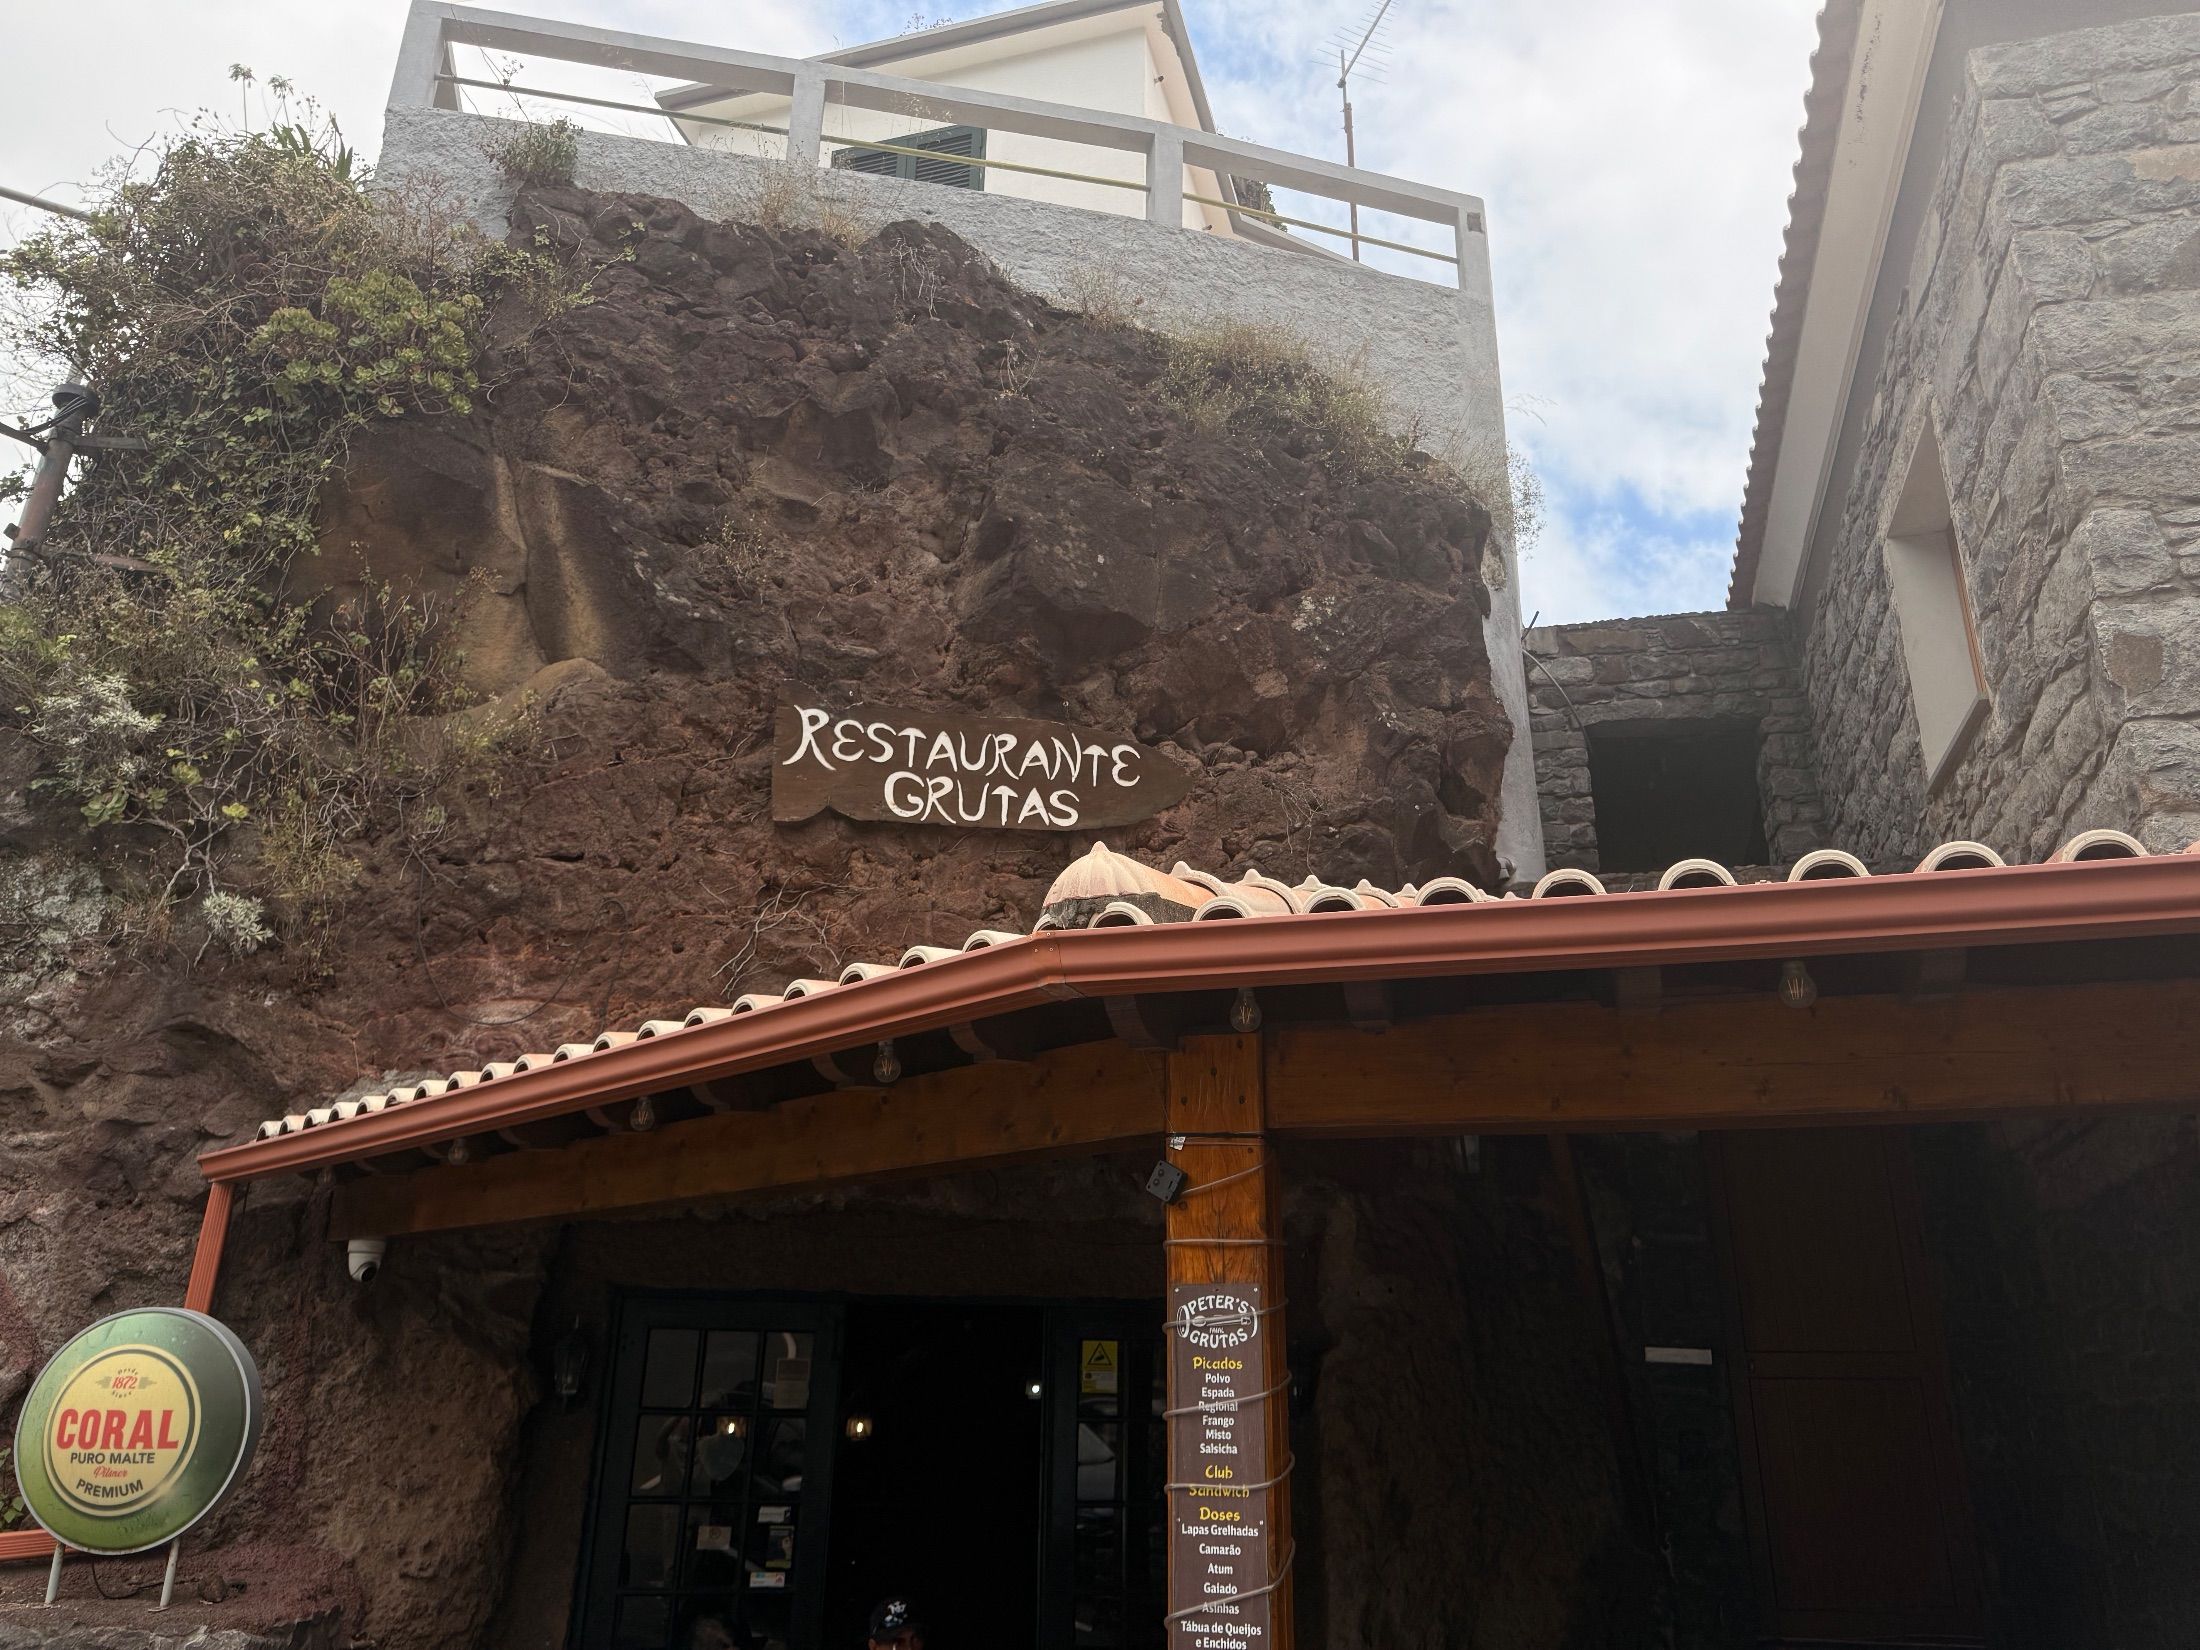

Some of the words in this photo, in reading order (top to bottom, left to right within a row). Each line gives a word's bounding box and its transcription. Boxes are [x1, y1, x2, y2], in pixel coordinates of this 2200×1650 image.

[782, 704, 1141, 788] RESTAURANTE
[884, 771, 1080, 827] GRUTAS
[1189, 1295, 1249, 1315] PETER'S
[1190, 1328, 1248, 1348] GRUTAS
[1192, 1356, 1243, 1370] Picados
[111, 1375, 138, 1389] 1872
[1205, 1373, 1231, 1384] Polvo
[1201, 1387, 1235, 1399] Espada
[1198, 1401, 1238, 1413] Regional
[1202, 1415, 1235, 1428] Frango
[56, 1408, 179, 1450] CORAL
[1205, 1429, 1232, 1440] Misto
[1200, 1443, 1238, 1455] Salsicha
[70, 1452, 105, 1464] PURO
[109, 1452, 155, 1464] MALTE
[93, 1465, 128, 1479] Pilsner
[1205, 1465, 1233, 1479] Club
[76, 1478, 144, 1498] PREMIUM
[1189, 1483, 1250, 1498] Sandwich
[1199, 1506, 1241, 1521] Doses
[1181, 1523, 1209, 1537] Lapas
[1210, 1524, 1259, 1537] Grelhadas
[1199, 1543, 1241, 1556] Camarão
[1207, 1563, 1233, 1575] Atum
[1201, 1601, 1239, 1615] Asinhas
[1180, 1620, 1210, 1633] Tábua
[1211, 1621, 1223, 1633] de
[1225, 1622, 1261, 1638] Queijos
[1195, 1639, 1202, 1648] e
[1203, 1637, 1247, 1650] Enchidos
